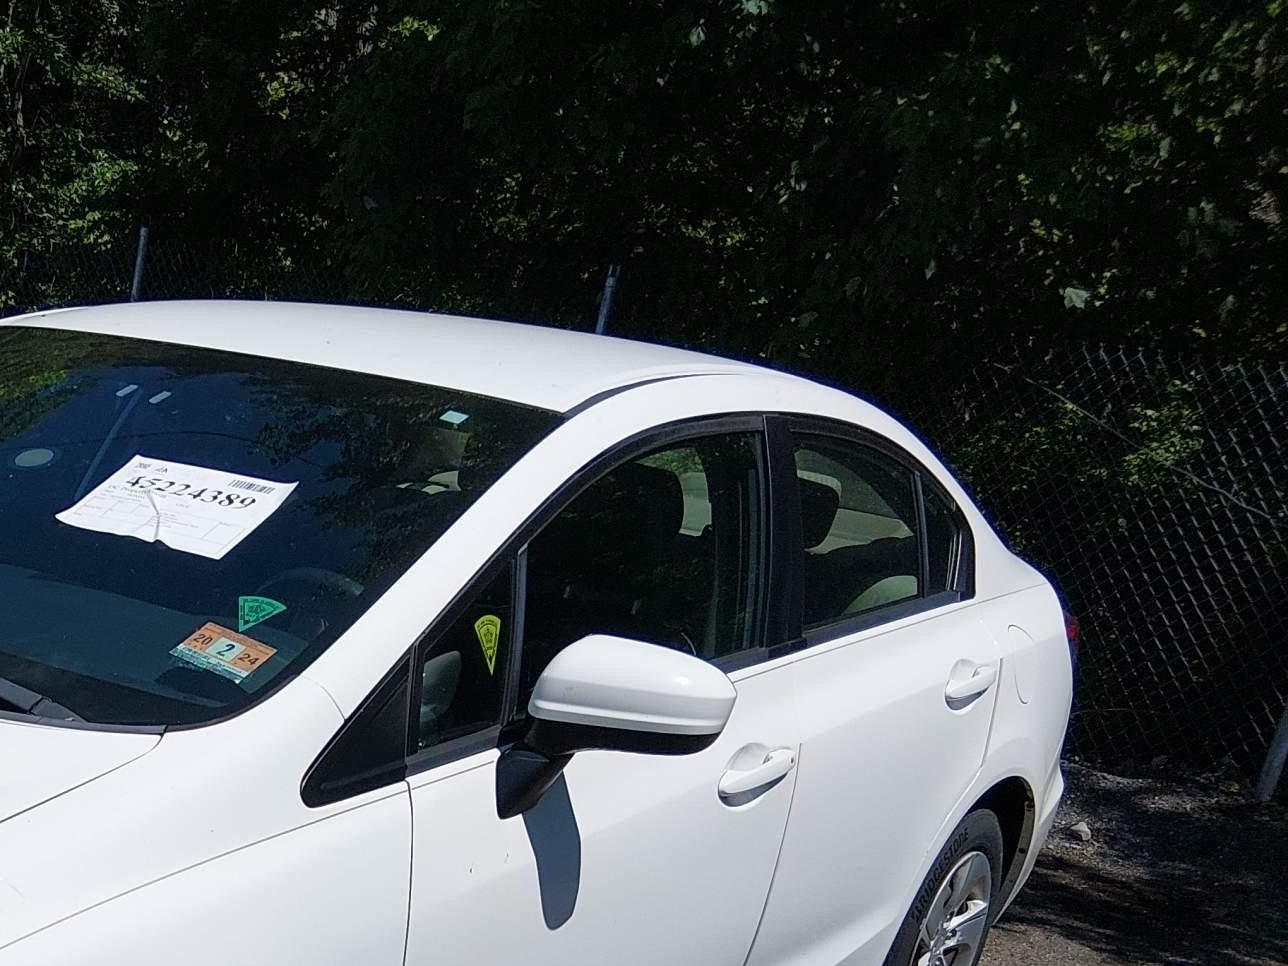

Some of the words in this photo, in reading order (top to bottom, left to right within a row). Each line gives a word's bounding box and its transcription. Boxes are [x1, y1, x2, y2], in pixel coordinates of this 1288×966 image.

[125, 475, 257, 509] 45224389
[193, 633, 214, 646] 20
[215, 643, 236, 657] 2
[238, 652, 260, 666] 24
